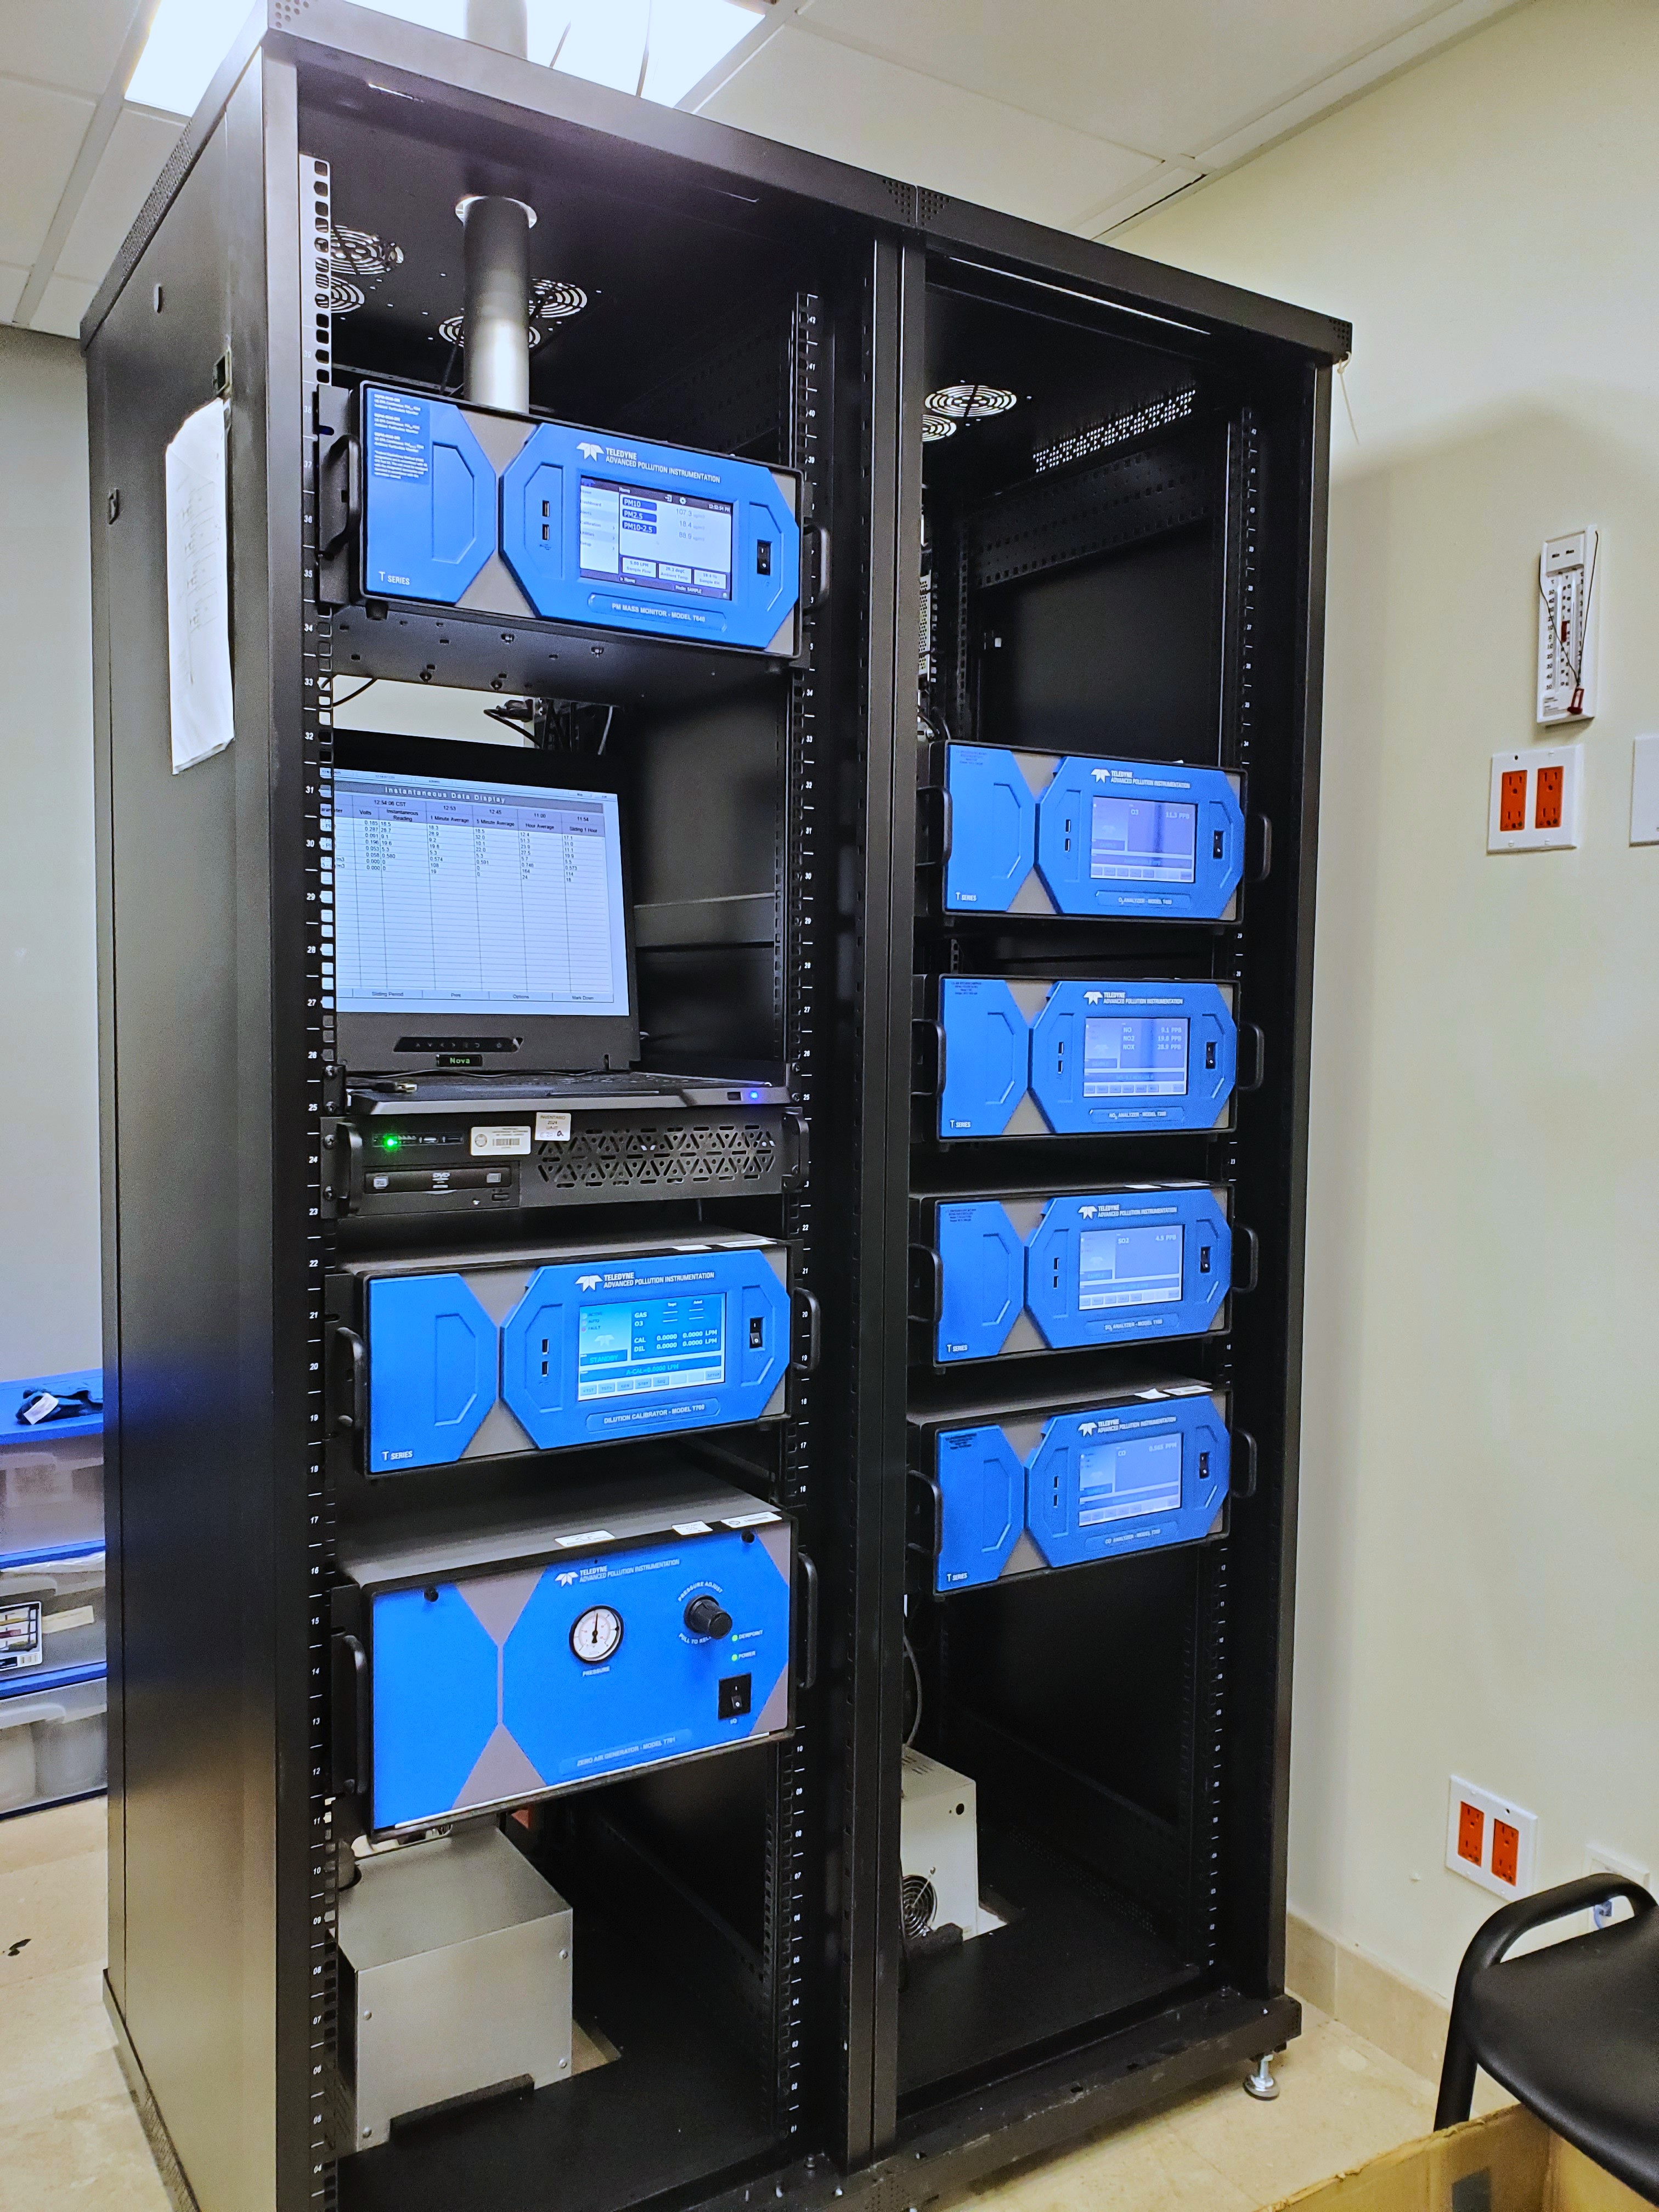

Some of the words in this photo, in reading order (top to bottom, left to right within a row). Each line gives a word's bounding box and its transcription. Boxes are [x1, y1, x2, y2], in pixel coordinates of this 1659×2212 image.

[606, 447, 637, 460] TELEDYNE
[605, 456, 636, 467] ADVANCED
[638, 461, 668, 474] POLLUTION
[669, 467, 720, 483] INSTRUMENTATION
[624, 498, 641, 507] PM10
[624, 510, 643, 520] PM2.5
[624, 522, 652, 533] PM10-2.5
[304, 569, 313, 578] 35
[379, 572, 385, 582] T
[387, 575, 410, 585] SERIES
[640, 608, 667, 617] MONITOR
[672, 612, 691, 620] MODEL
[304, 624, 313, 632] 34
[305, 732, 314, 740] 32
[1111, 770, 1133, 778] TELEDYNE
[385, 787, 447, 798] Instantaneous
[474, 795, 505, 804] Display
[956, 891, 961, 901] T
[950, 1119, 955, 1128] T
[604, 1272, 634, 1281] TELEDYNE
[604, 1280, 634, 1289] ADVANCED
[635, 1277, 664, 1285] POLLUTION
[665, 1272, 714, 1283] INSTRUMENTATION
[947, 1344, 952, 1353] T
[590, 1355, 618, 1363] STANDBY
[604, 1415, 631, 1424] DILUTION
[631, 1409, 668, 1420] CALIBRATOR
[672, 1406, 691, 1415] MODEL
[1098, 1418, 1120, 1427] TELEDYNE
[382, 1451, 389, 1461] T
[391, 1451, 413, 1460] SERIES
[579, 1572, 607, 1583] ADVANCED
[607, 1567, 634, 1578] POLLUTION
[634, 1559, 680, 1573] INSTRUMENTATION
[580, 1565, 607, 1576] TELEDYNE
[947, 1573, 952, 1582] T
[952, 1572, 968, 1581] SERIES
[678, 1581, 704, 1601] PRESSURE
[704, 1581, 723, 1593] ADJUST
[679, 1633, 690, 1644] PULL
[738, 1629, 763, 1640] DEWPOINT
[738, 1650, 756, 1658] POWER
[582, 1666, 610, 1677] PRESSURE
[577, 1757, 593, 1767] ZERO
[605, 1746, 639, 1759] GENERATOR
[642, 1740, 662, 1750] MODEL
[313, 1767, 320, 1775] 12
[313, 1866, 321, 1875] 10
[313, 2015, 322, 2024] 07
